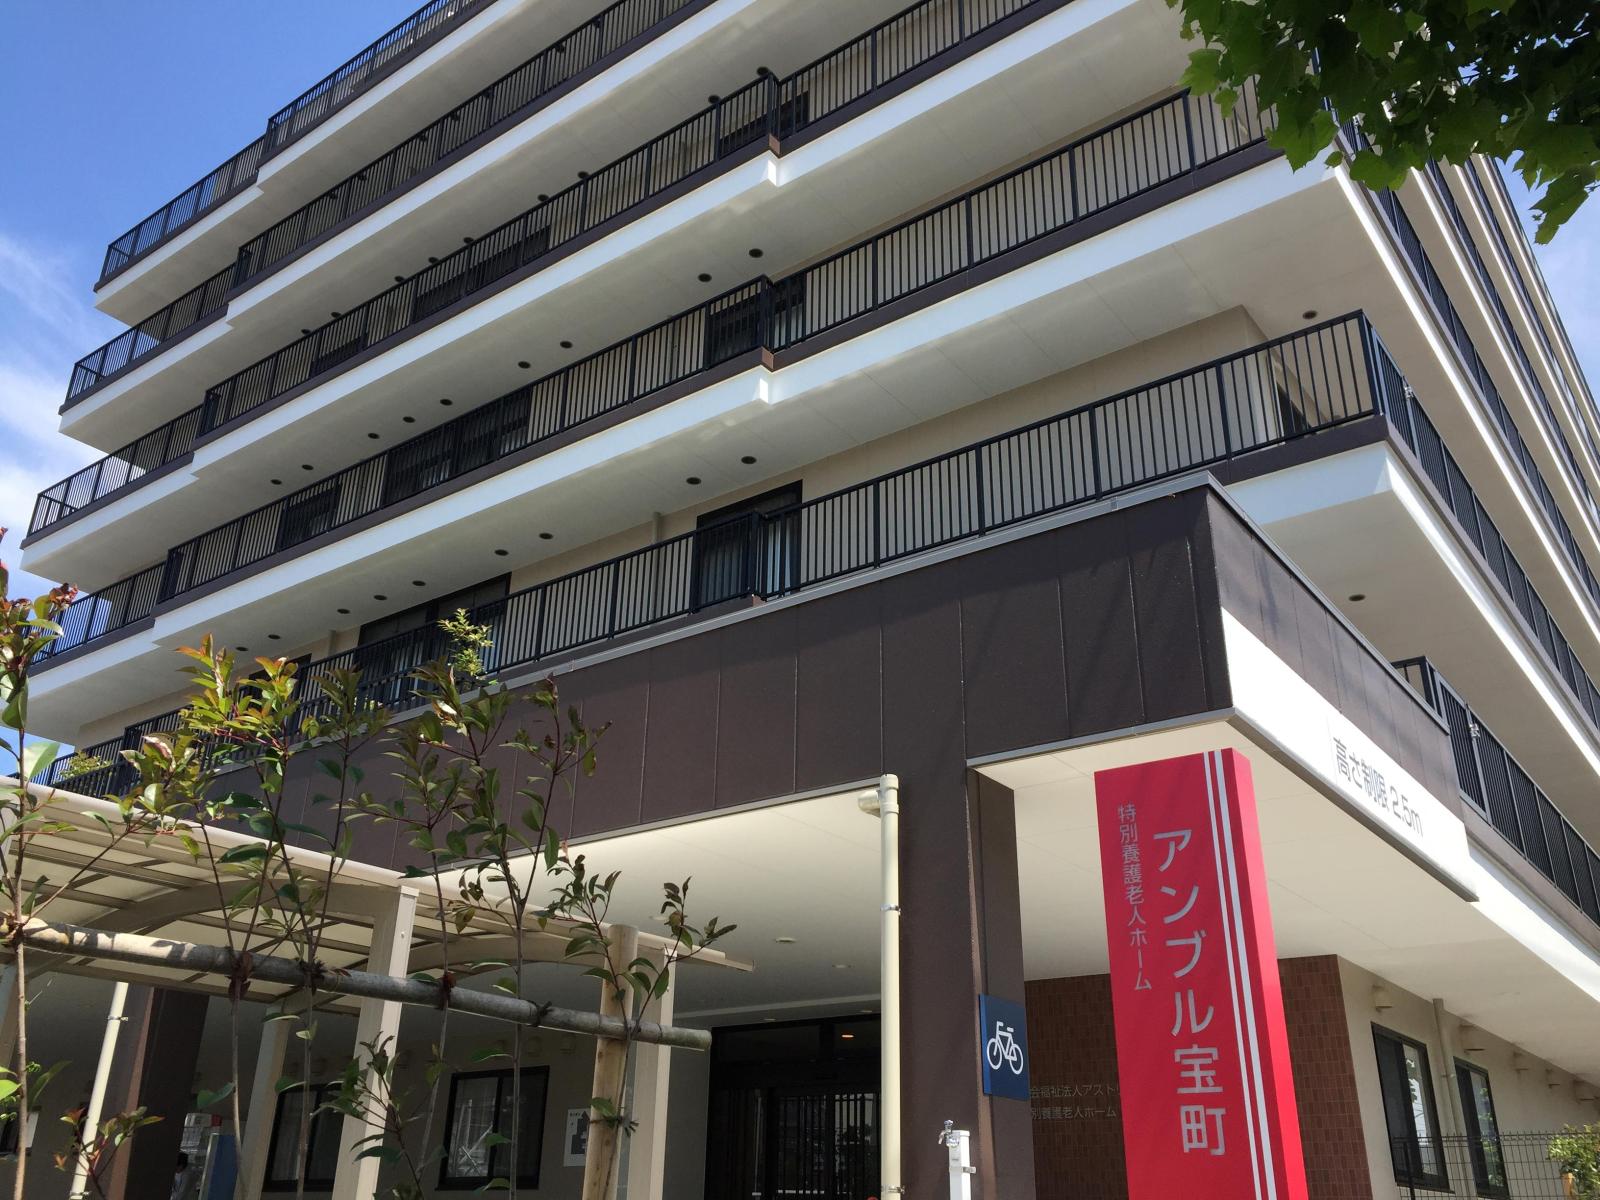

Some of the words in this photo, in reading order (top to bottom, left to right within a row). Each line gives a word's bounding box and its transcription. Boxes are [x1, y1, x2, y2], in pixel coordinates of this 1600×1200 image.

[1116, 801, 1152, 991] 特別養護老人ホーム
[1153, 828, 1227, 1157] アンブル宝町
